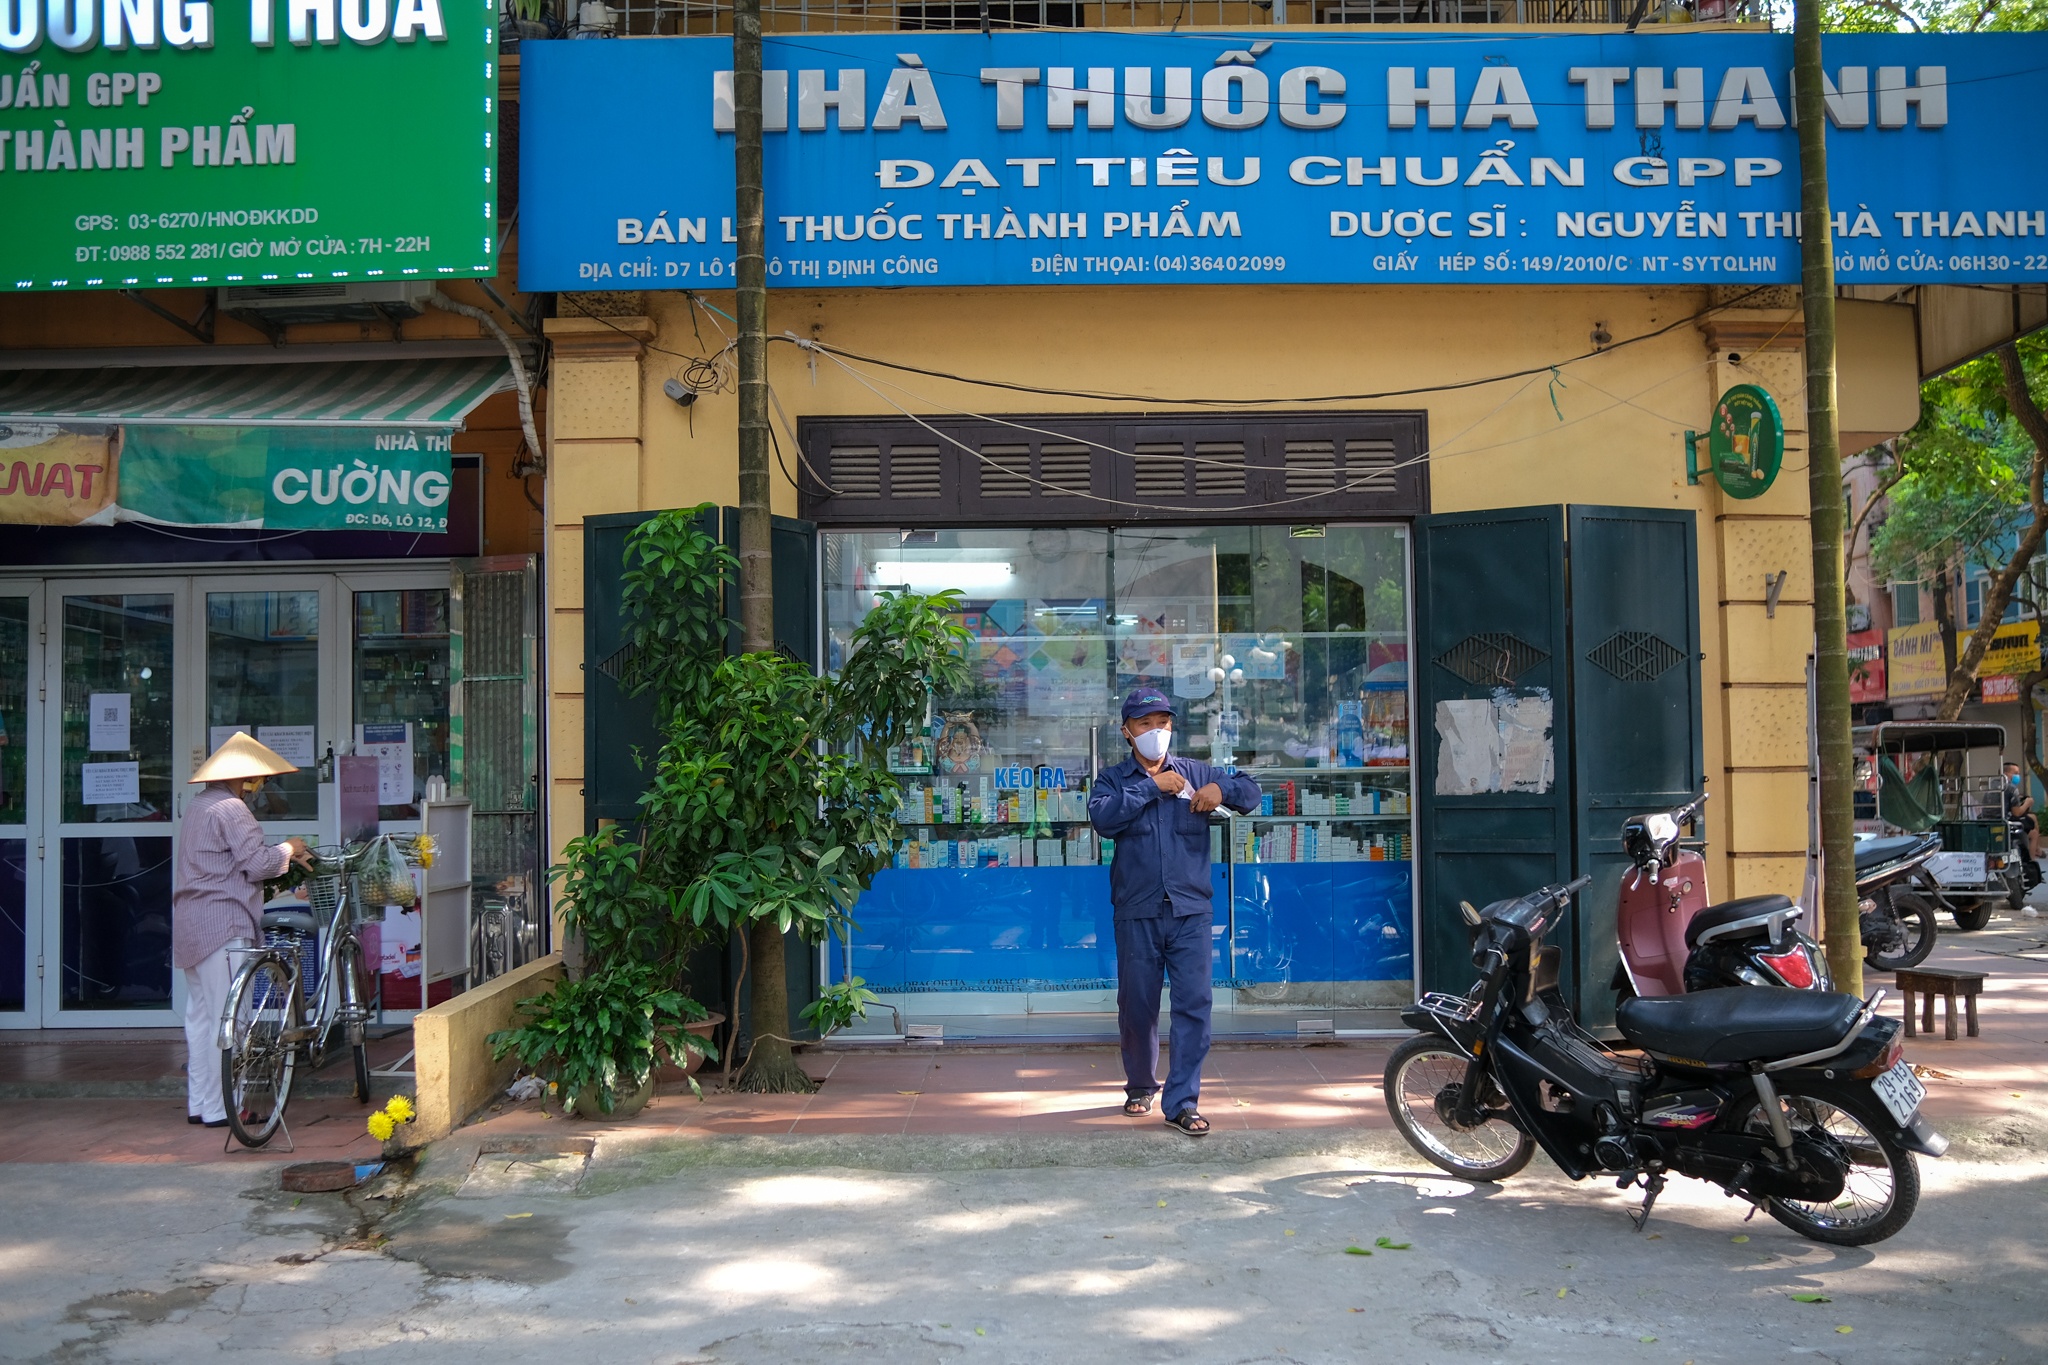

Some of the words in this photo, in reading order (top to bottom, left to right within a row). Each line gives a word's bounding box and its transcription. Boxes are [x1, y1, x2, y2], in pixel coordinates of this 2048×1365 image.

[87, 72, 162, 107] GPP
[713, 53, 948, 133] NHÀ
[980, 41, 1347, 130] THUỐC
[1568, 66, 1948, 130] THANH
[161, 106, 297, 168] PHẨM
[875, 158, 1056, 197] ĐẠT
[1076, 148, 1261, 187] TIÊU
[1289, 139, 1585, 187] CHUẨN
[1613, 157, 1783, 188] GPP
[75, 214, 119, 231] GPS:
[617, 210, 706, 244] BÁN
[722, 217, 737, 243] L
[779, 201, 922, 242] THUỐC
[937, 205, 1087, 240] THÀNH
[1103, 199, 1242, 238] PHẨM
[1330, 208, 1453, 244] DƯỢC
[1468, 203, 1506, 237] SĨ
[1557, 200, 1727, 238] NGUYỄN
[1894, 210, 2045, 237] THANH
[155, 243, 185, 260] 552
[228, 238, 264, 258] GIỜ
[270, 236, 302, 257] MỞ
[1372, 250, 1419, 271] GIẤY
[1483, 249, 1517, 271] SỐ:
[1833, 250, 1854, 271] IỜ
[1860, 248, 1890, 271] MỞ
[1896, 249, 1943, 271] CỬA:
[579, 262, 613, 282] ĐỊA
[619, 256, 658, 278] CHỈ:
[665, 262, 690, 277] D7
[700, 257, 723, 277] LÔ
[764, 257, 783, 276] Ô
[788, 260, 820, 279] THỊ
[827, 259, 875, 279] ĐỊNH
[882, 255, 938, 275] CÔNG
[1031, 253, 1078, 276] ĐIỆN
[375, 430, 419, 450] NHÀ
[272, 458, 450, 507] CƯỜNG
[345, 513, 369, 524] ĐC:
[396, 513, 413, 527] LÔ
[994, 762, 1035, 790] KÉO
[1039, 766, 1068, 790] RA
[1044, 981, 1107, 992] ORACORTIA
[1893, 1079, 1921, 1120] 2169
